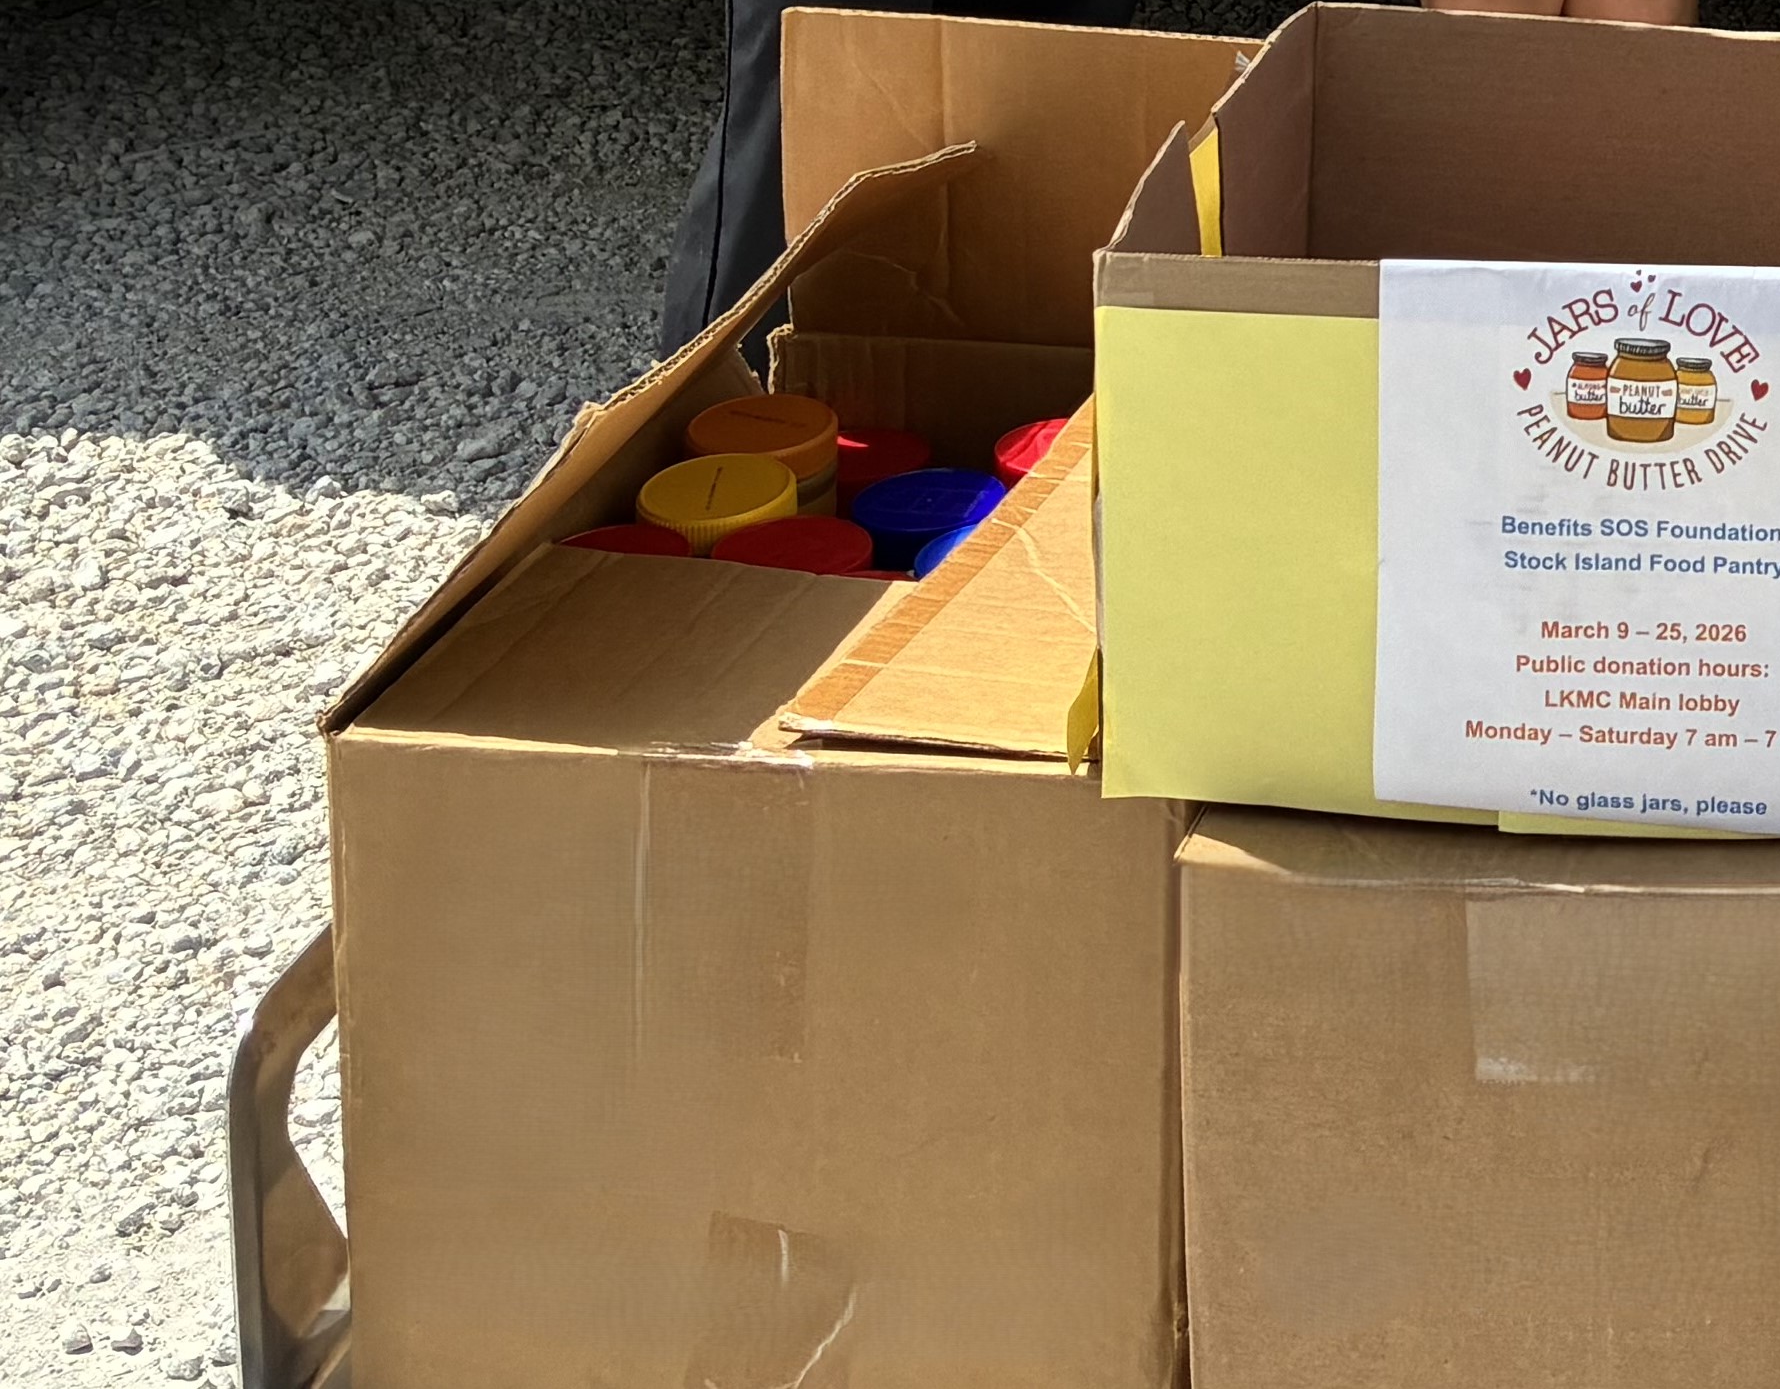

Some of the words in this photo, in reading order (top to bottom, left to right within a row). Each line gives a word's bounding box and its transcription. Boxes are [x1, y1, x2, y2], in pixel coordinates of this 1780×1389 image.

[1526, 288, 1620, 365] JARS
[1627, 292, 1656, 332] of
[1658, 289, 1761, 374] LOVE
[1622, 384, 1661, 398] PEANUT
[1619, 395, 1667, 416] butter
[1516, 404, 1601, 480] PEANUT
[1606, 457, 1703, 491] BUTTER
[1704, 412, 1769, 475] DRIVE
[1501, 515, 1593, 538] Benefits
[1599, 518, 1650, 539] SOS
[1503, 550, 1568, 572] Stock
[1573, 552, 1644, 573] Island
[1649, 554, 1706, 575] Food
[1540, 621, 1610, 641] March
[1616, 621, 1630, 641] 9
[1655, 622, 1689, 645] 25,
[1694, 623, 1747, 643] 2026
[1515, 654, 1587, 674] Public
[1592, 656, 1692, 677] donation
[1698, 658, 1770, 678] hours:
[1544, 690, 1612, 710] LKMC
[1618, 691, 1672, 711] Main
[1677, 693, 1741, 717] lobby
[1464, 720, 1553, 746] Monday
[1579, 724, 1679, 750] Saturday
[1685, 728, 1697, 746] 7
[1703, 733, 1739, 748] am
[1765, 730, 1777, 748] 7
[1575, 790, 1635, 814] glass
[1640, 792, 1690, 815] jars,
[1695, 794, 1768, 818] please
